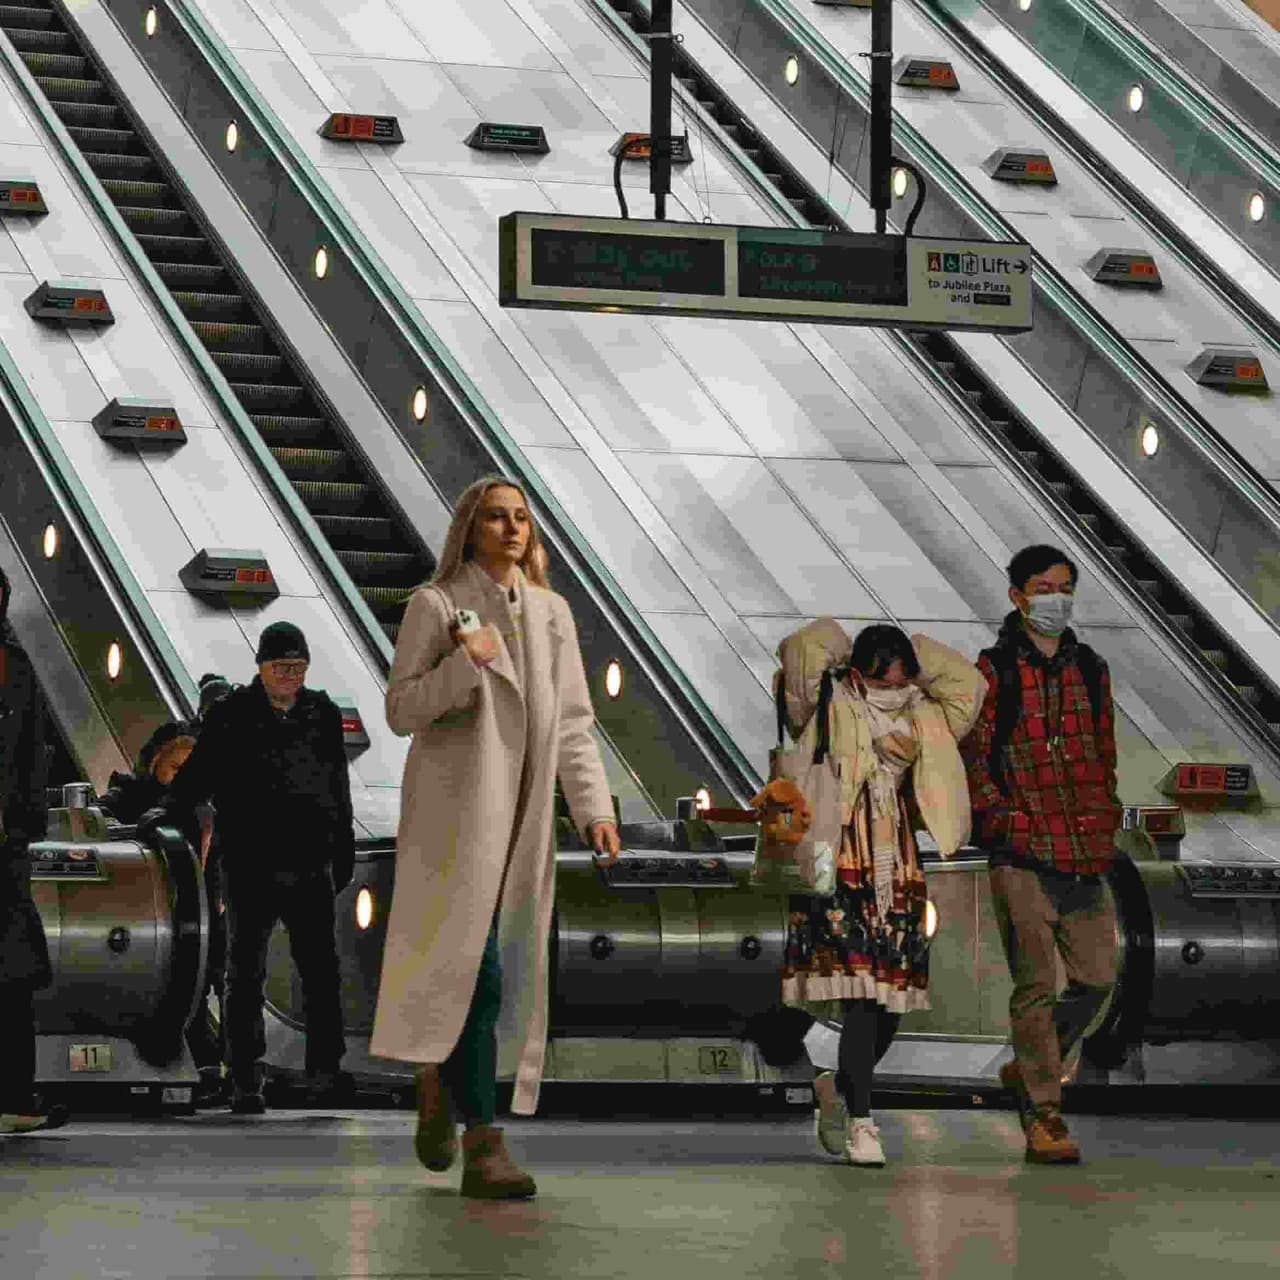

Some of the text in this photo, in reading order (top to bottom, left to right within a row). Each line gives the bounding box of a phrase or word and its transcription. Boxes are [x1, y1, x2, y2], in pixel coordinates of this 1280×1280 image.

[982, 257, 1011, 275] Lift
[928, 278, 941, 289] to
[942, 279, 982, 292] Jubilee
[950, 293, 971, 304] and
[80, 1046, 98, 1066] 11
[709, 1048, 730, 1072] 12
